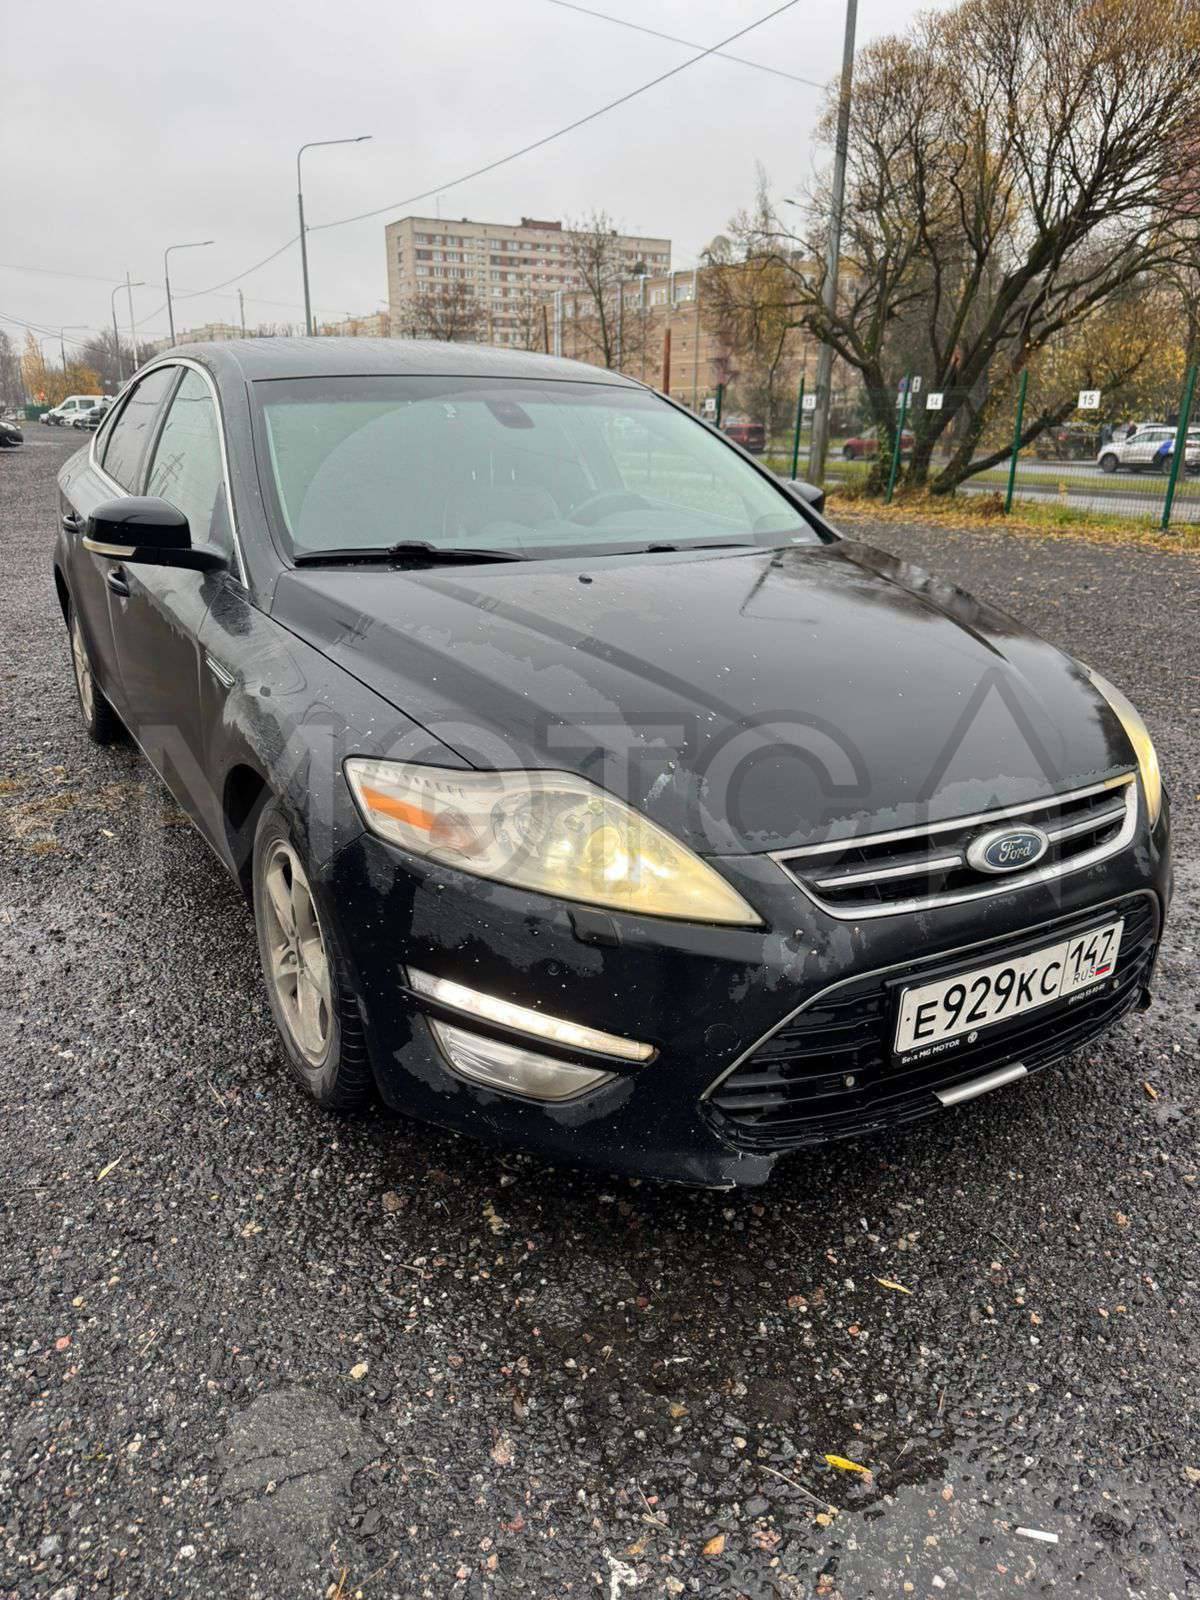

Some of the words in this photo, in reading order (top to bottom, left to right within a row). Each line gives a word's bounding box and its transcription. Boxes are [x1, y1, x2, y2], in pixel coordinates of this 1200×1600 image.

[1082, 393, 1096, 406] 15
[998, 838, 1032, 862] Ford
[912, 961, 1061, 1040] E929KC
[1070, 928, 1115, 973] 147
[1072, 966, 1096, 985] RUS
[932, 1039, 960, 1054] MOTOR
